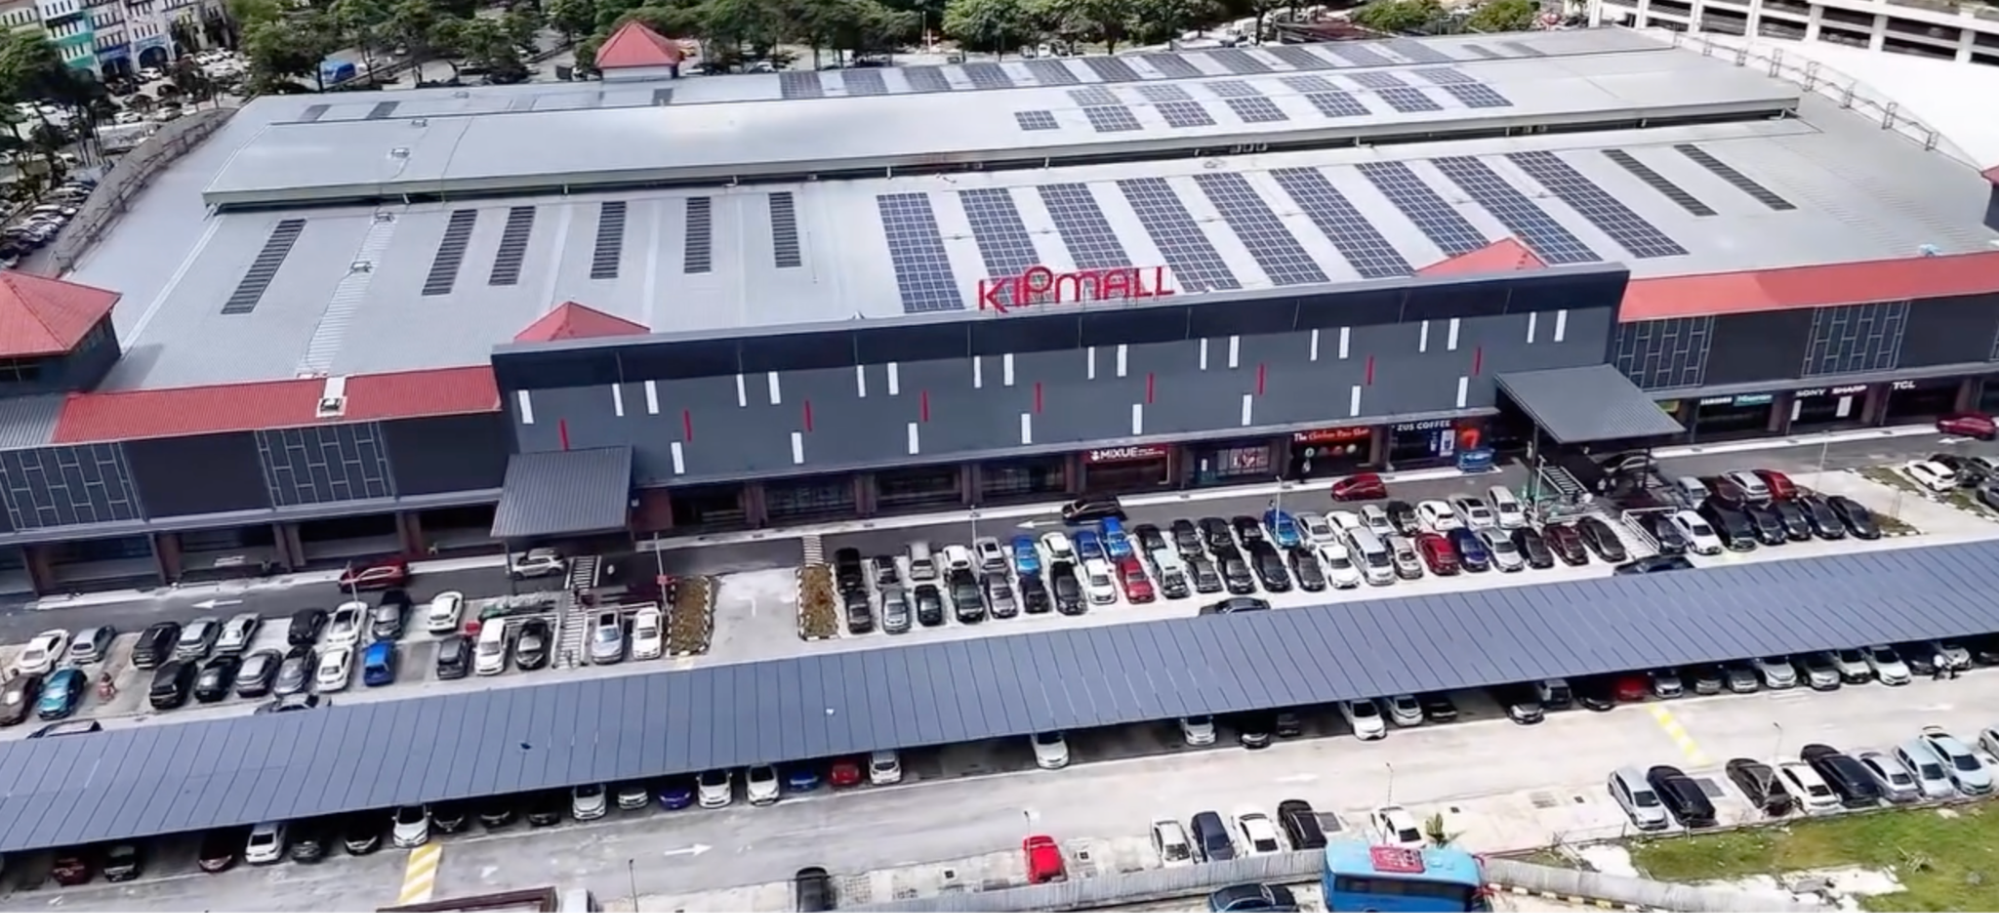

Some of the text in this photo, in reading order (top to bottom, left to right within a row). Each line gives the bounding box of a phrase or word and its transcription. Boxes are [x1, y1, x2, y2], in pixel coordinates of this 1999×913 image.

[1892, 380, 1916, 391] TCL
[1397, 419, 1451, 431] ZUS COFFEE
[1100, 447, 1138, 460] MIXUE
